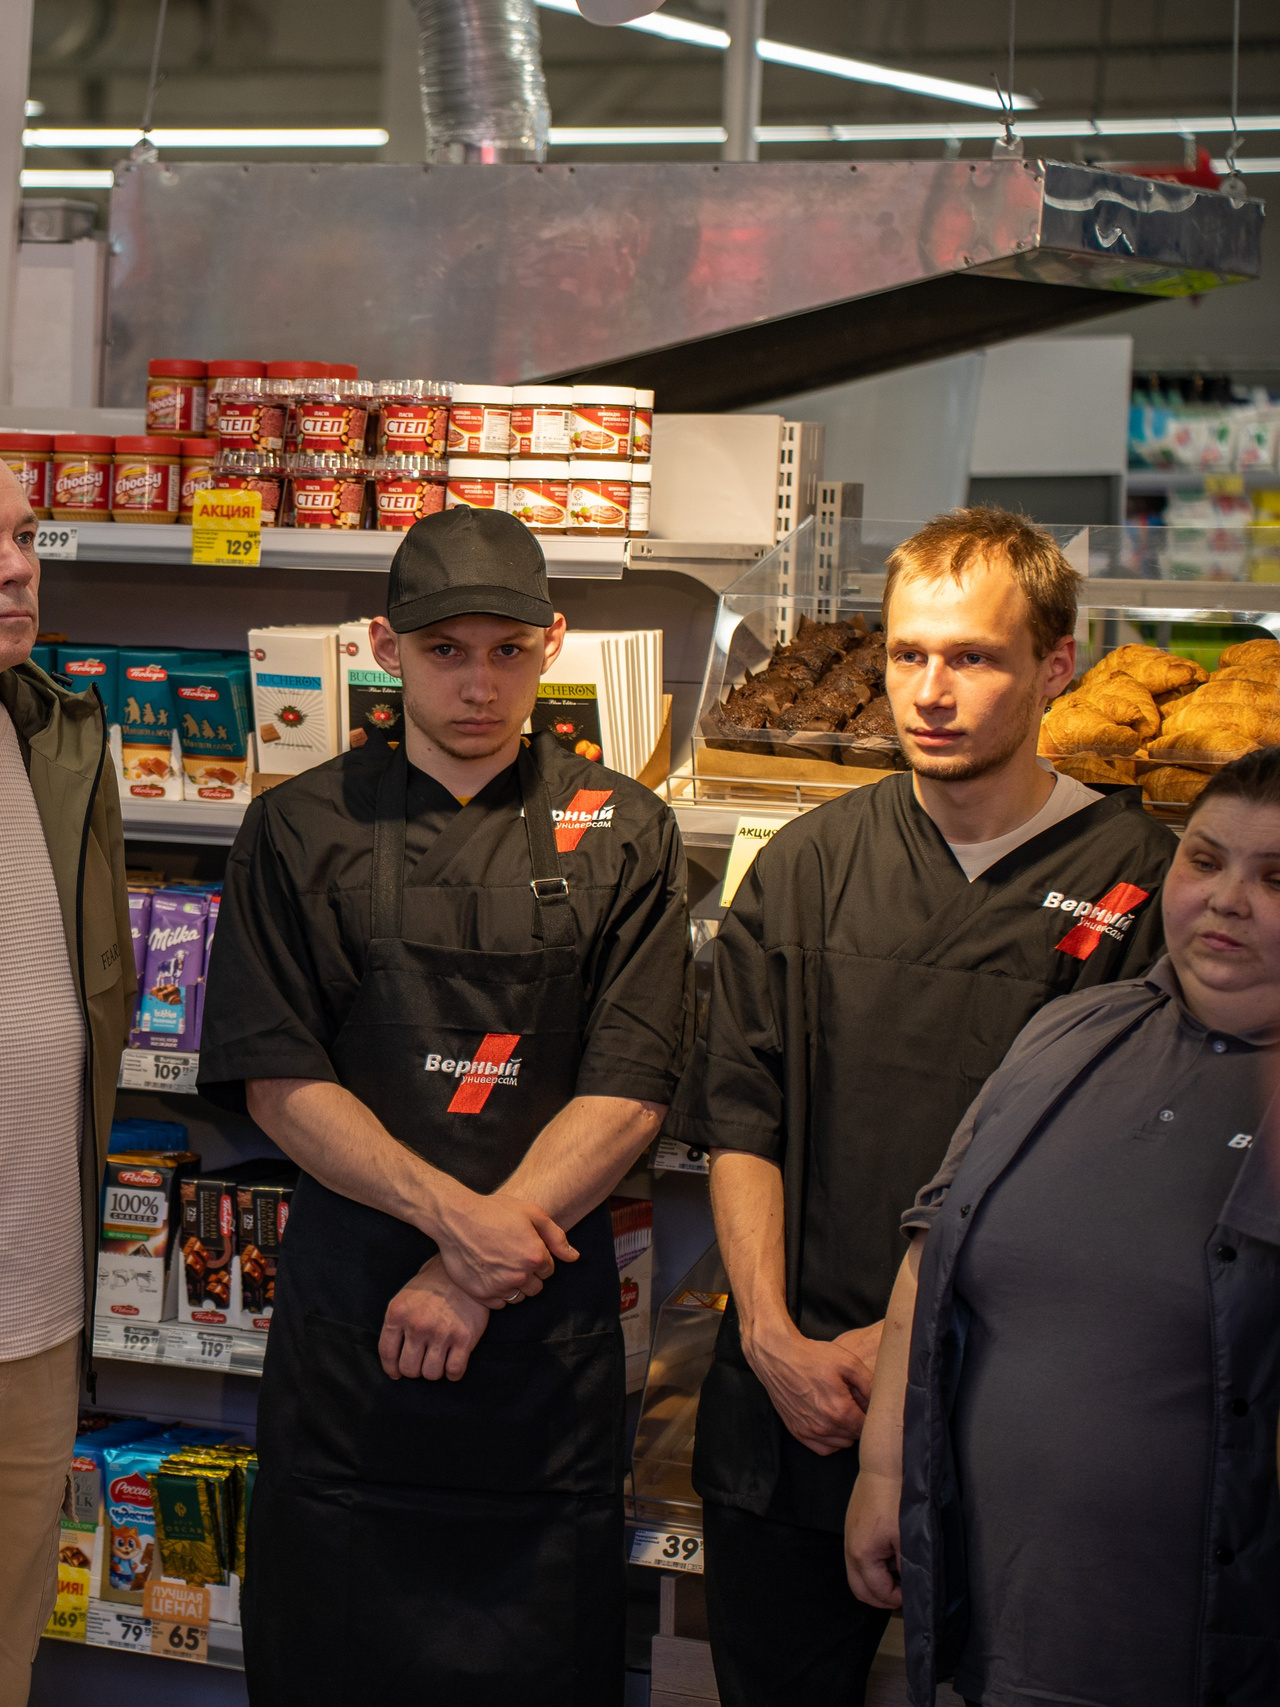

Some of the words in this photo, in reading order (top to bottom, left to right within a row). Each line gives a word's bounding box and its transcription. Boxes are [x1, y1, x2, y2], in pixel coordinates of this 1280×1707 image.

[303, 419, 343, 433] СТЕП
[386, 419, 430, 434] СТЕП
[16, 468, 38, 485] osy
[55, 470, 104, 493] Choosy
[115, 472, 162, 495] Choosy
[182, 477, 215, 496] Choo
[296, 492, 334, 507] СТЕП
[379, 495, 417, 510] СТЕП
[199, 504, 256, 521] АКЦИЯ!
[38, 532, 69, 548] 299
[227, 540, 252, 556] 129
[68, 661, 104, 675] Победа
[130, 667, 165, 681] Победа
[256, 673, 322, 688] BUCHERON
[350, 671, 403, 684] BUCHER
[181, 687, 218, 700] Победа
[538, 685, 595, 697] UCHERON
[521, 805, 616, 822] рный
[555, 820, 612, 830] универсам
[1042, 892, 1135, 931] Верный
[148, 925, 200, 951] Milka
[154, 1063, 181, 1080] 109
[424, 1053, 522, 1078] Верный
[461, 1075, 518, 1086] универсам
[121, 1172, 160, 1185] Pobeda
[110, 1193, 159, 1215] 100%
[279, 1206, 288, 1234] Побе
[201, 1341, 224, 1357] 119
[73, 1461, 94, 1471] беда
[76, 1495, 93, 1508] LK
[662, 1535, 699, 1561] 39
[58, 1581, 84, 1596] ИЯ!
[151, 1585, 203, 1605] ЛУЧШАЯ
[151, 1598, 203, 1619] ЦЕНА!
[52, 1611, 78, 1628] 169
[121, 1623, 143, 1642] 79
[169, 1625, 199, 1651] 65
